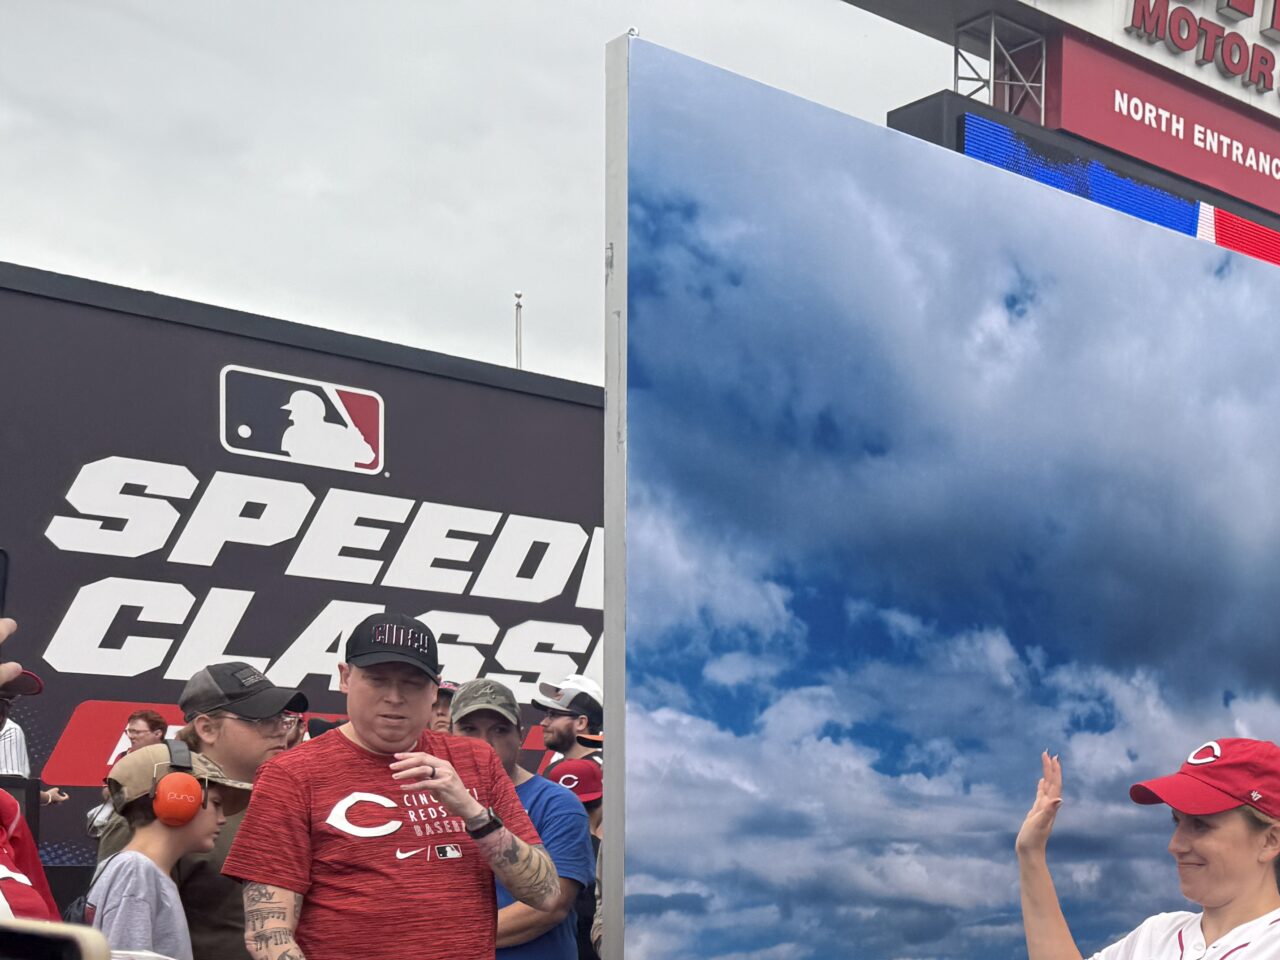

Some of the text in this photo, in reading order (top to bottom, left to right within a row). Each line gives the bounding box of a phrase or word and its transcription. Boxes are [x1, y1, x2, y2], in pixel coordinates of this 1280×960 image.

[1127, 0, 1277, 91] MOTOR
[1114, 90, 1184, 140] NORTH
[44, 456, 604, 610] SPEED
[42, 577, 604, 705] CLASS
[408, 805, 448, 822] REDS
